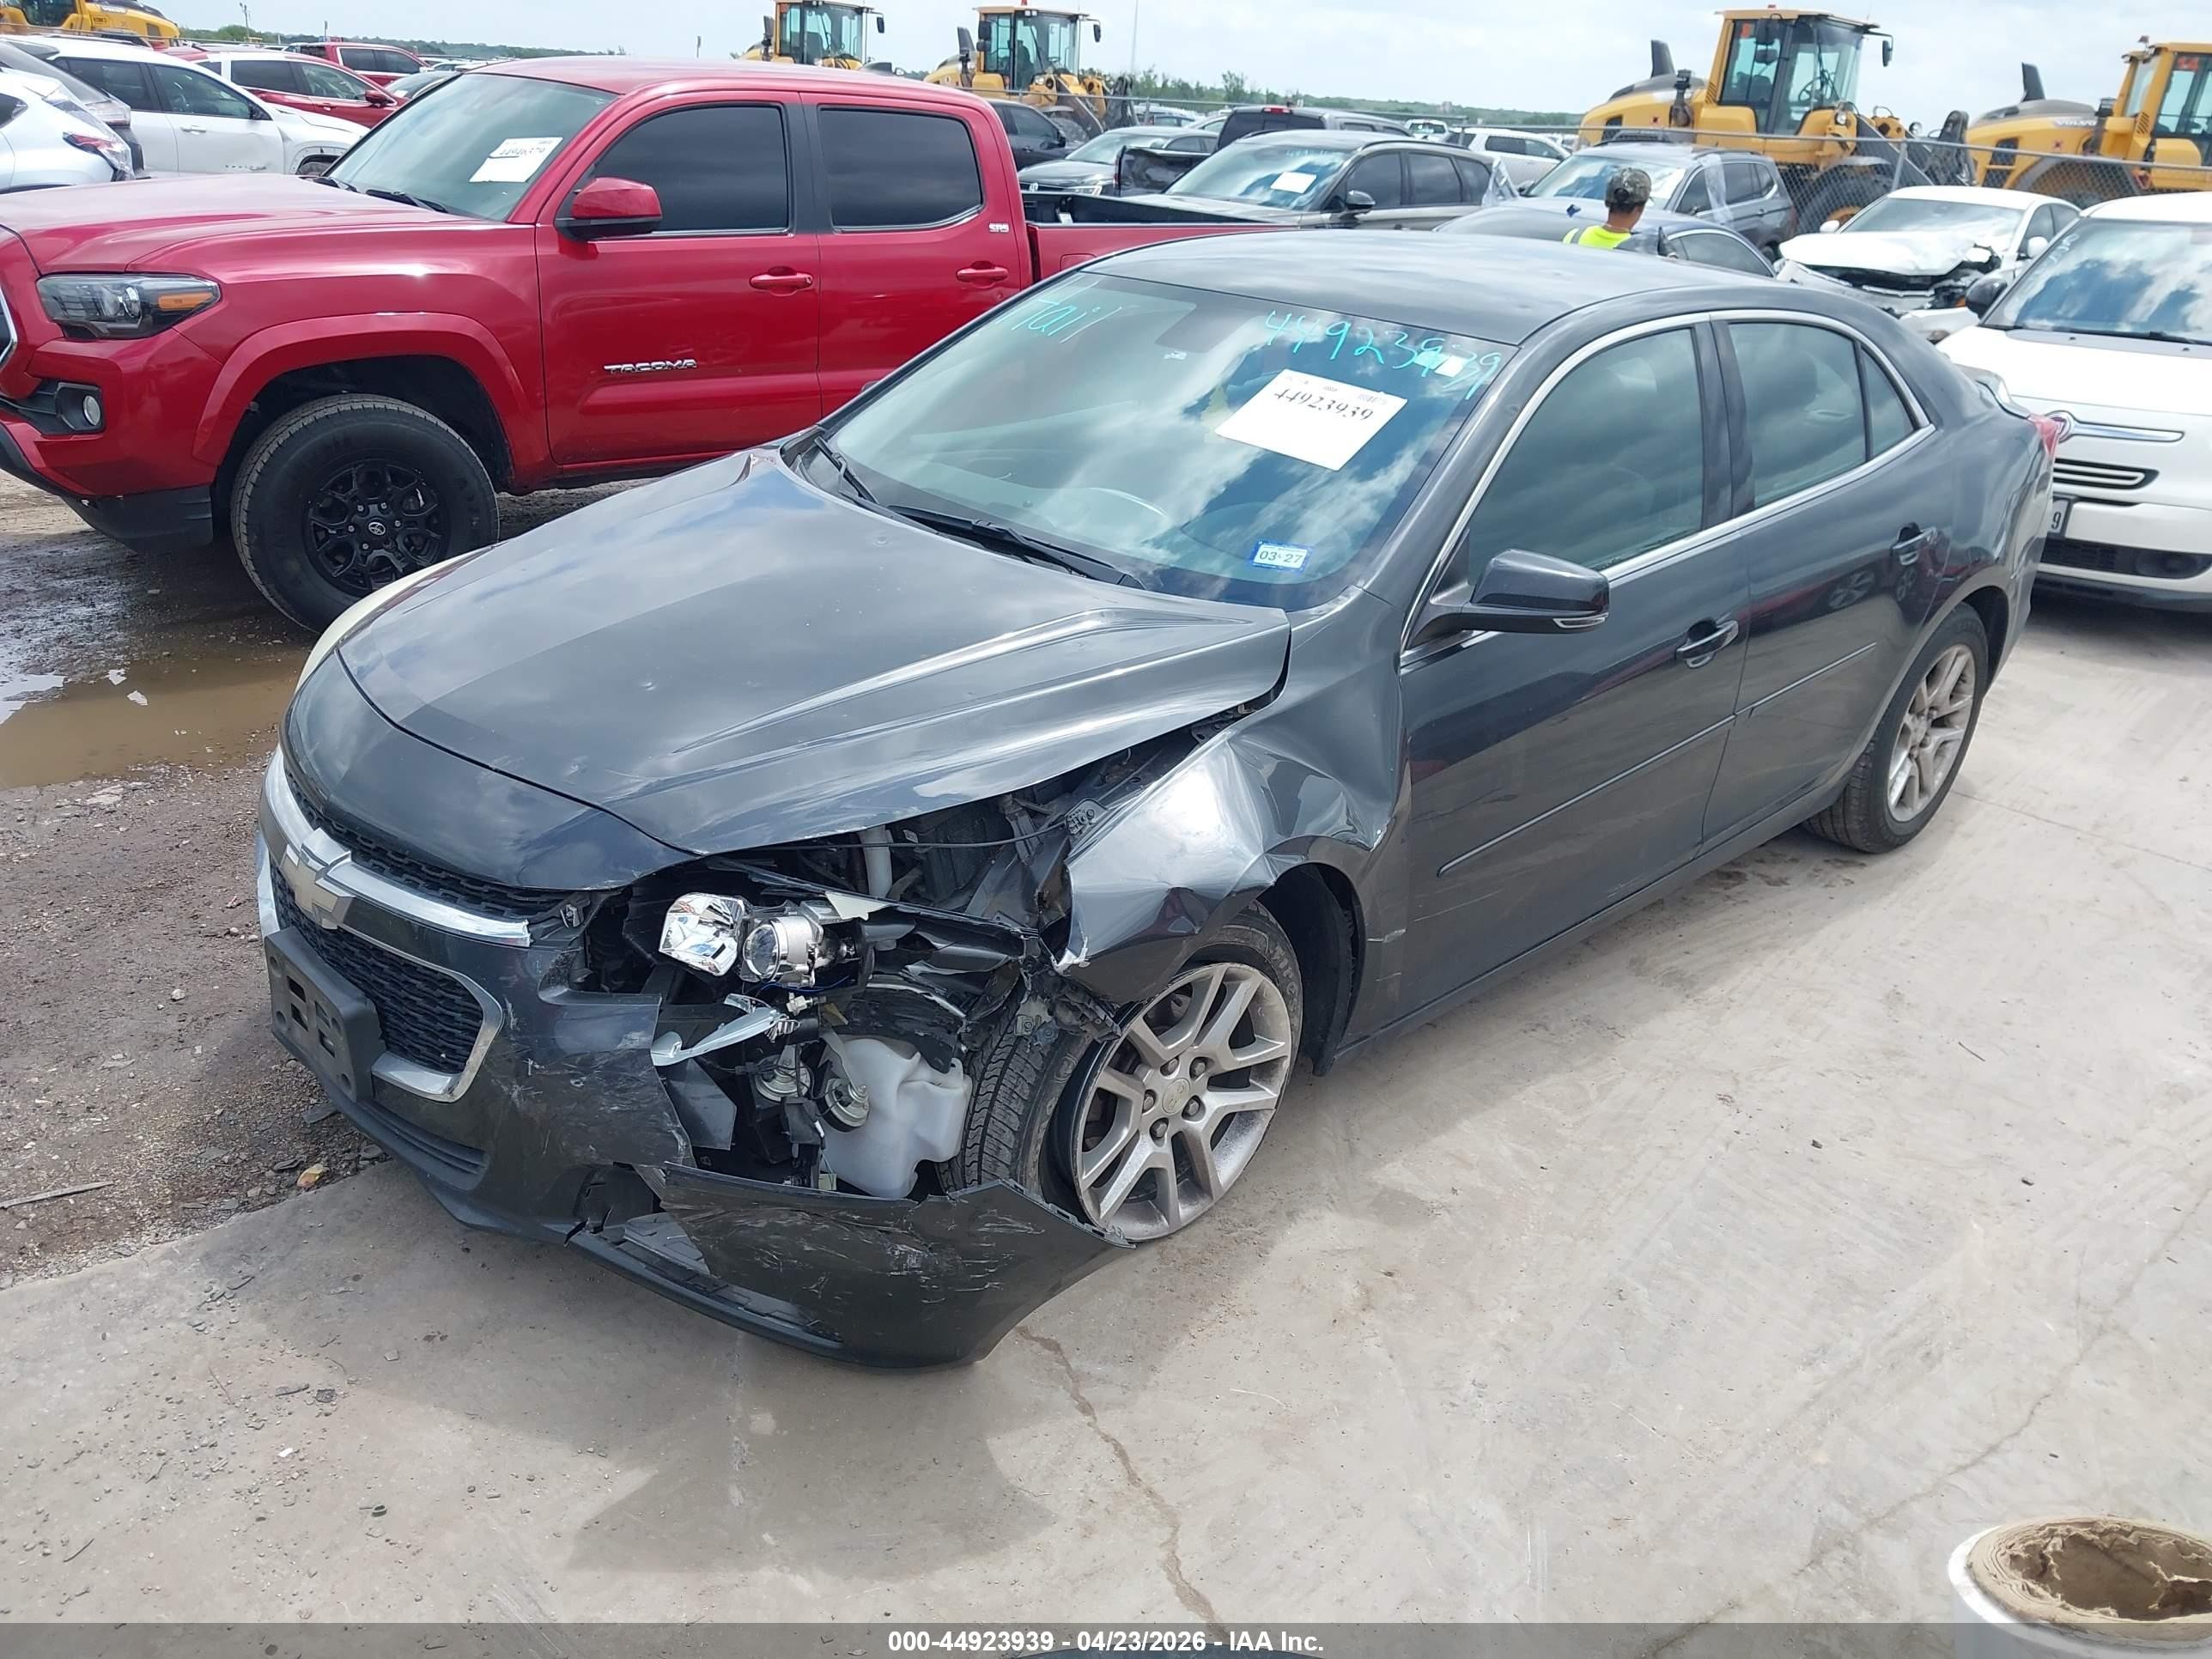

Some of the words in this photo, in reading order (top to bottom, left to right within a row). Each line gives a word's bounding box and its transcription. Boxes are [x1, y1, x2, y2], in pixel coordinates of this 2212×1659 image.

[604, 359, 697, 374] TACOMA
[1264, 310, 1503, 400] 44923939
[1273, 387, 1375, 421] 44923939
[1259, 550, 1278, 561] 03
[1283, 553, 1304, 563] 27
